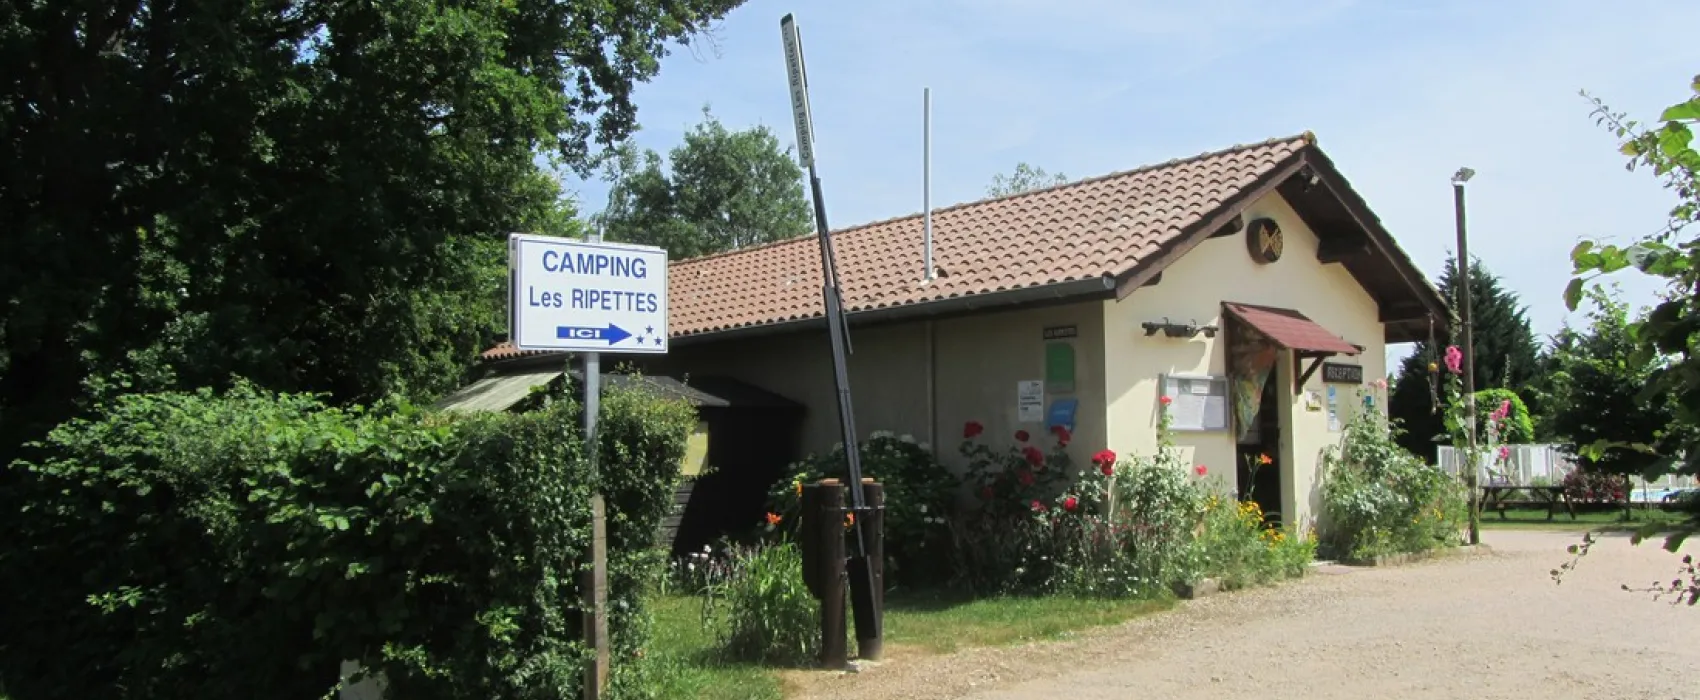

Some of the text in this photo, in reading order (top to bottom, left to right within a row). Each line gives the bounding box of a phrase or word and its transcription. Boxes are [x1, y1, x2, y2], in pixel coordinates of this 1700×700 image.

[798, 111, 811, 159] Camping
[542, 250, 647, 279] CAMPING
[529, 285, 658, 313] Les RIPETTES
[569, 328, 601, 339] ICI
